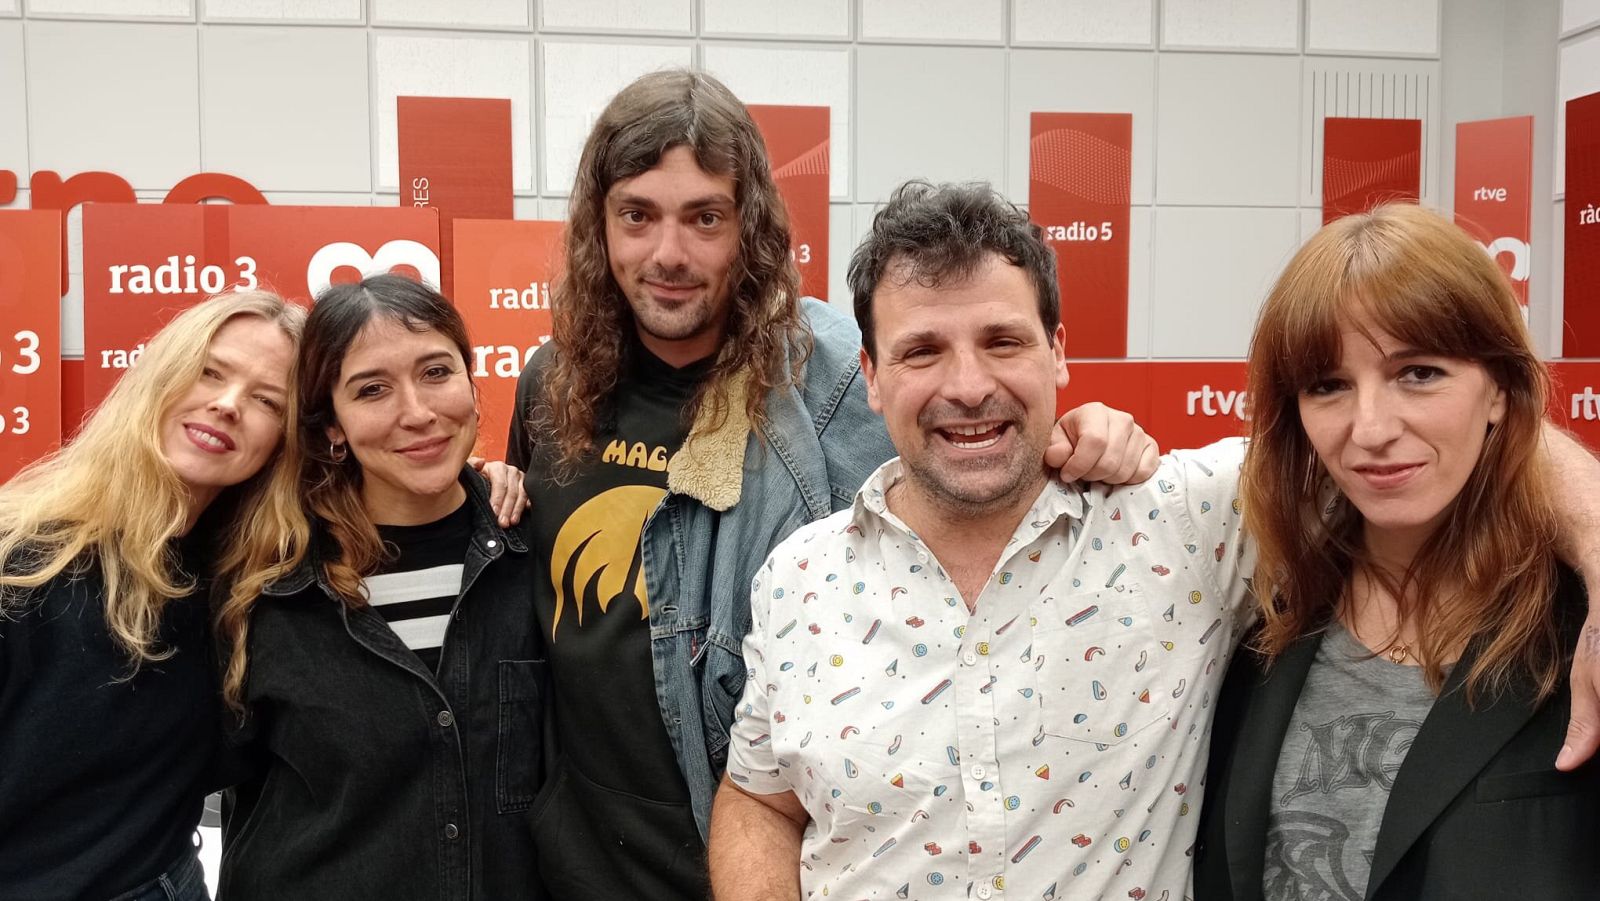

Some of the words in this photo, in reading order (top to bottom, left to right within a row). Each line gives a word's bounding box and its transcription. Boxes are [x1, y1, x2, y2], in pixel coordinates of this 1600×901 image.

[1474, 186, 1508, 202] rtve
[1047, 221, 1098, 241] radio
[1101, 221, 1113, 241] 5
[799, 243, 811, 264] 3
[109, 255, 226, 294] radio
[234, 256, 258, 293] 3
[12, 330, 41, 375] 3
[1571, 386, 1600, 421] rt
[11, 406, 31, 435] 3
[602, 439, 675, 472] MAG
